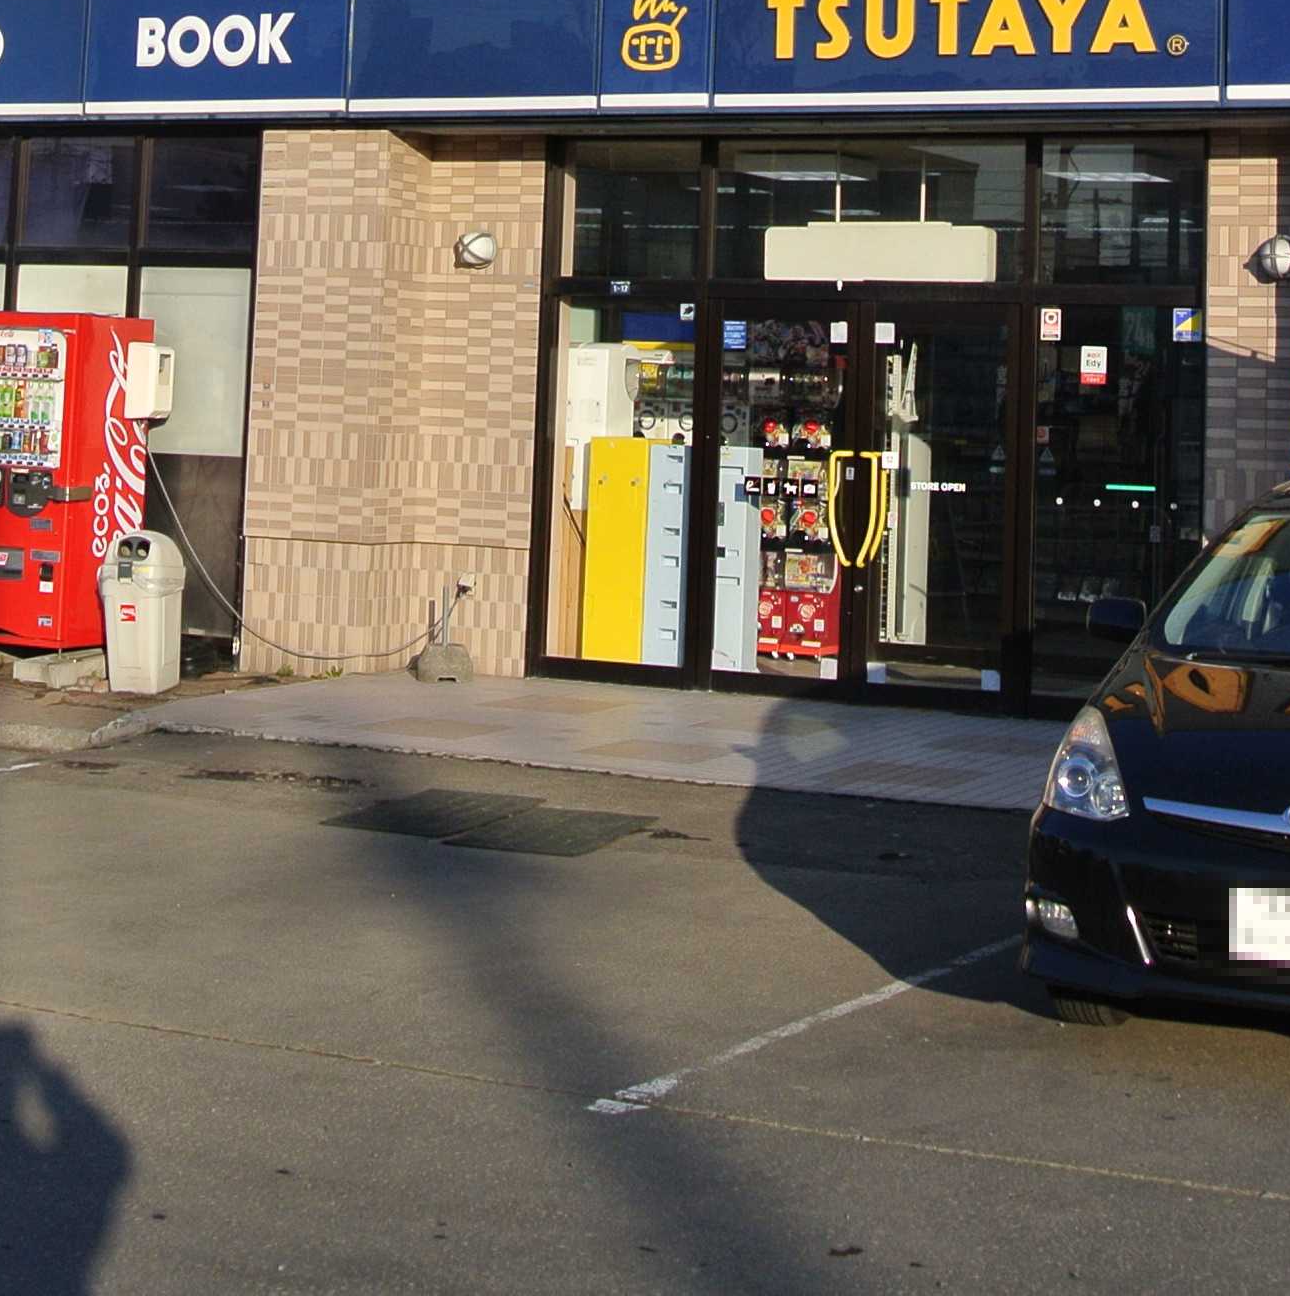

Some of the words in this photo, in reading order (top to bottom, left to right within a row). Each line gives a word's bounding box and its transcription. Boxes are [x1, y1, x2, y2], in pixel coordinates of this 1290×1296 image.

[135, 13, 295, 68] BOOK
[910, 482, 939, 491] STORE
[941, 482, 966, 492] OPEN
